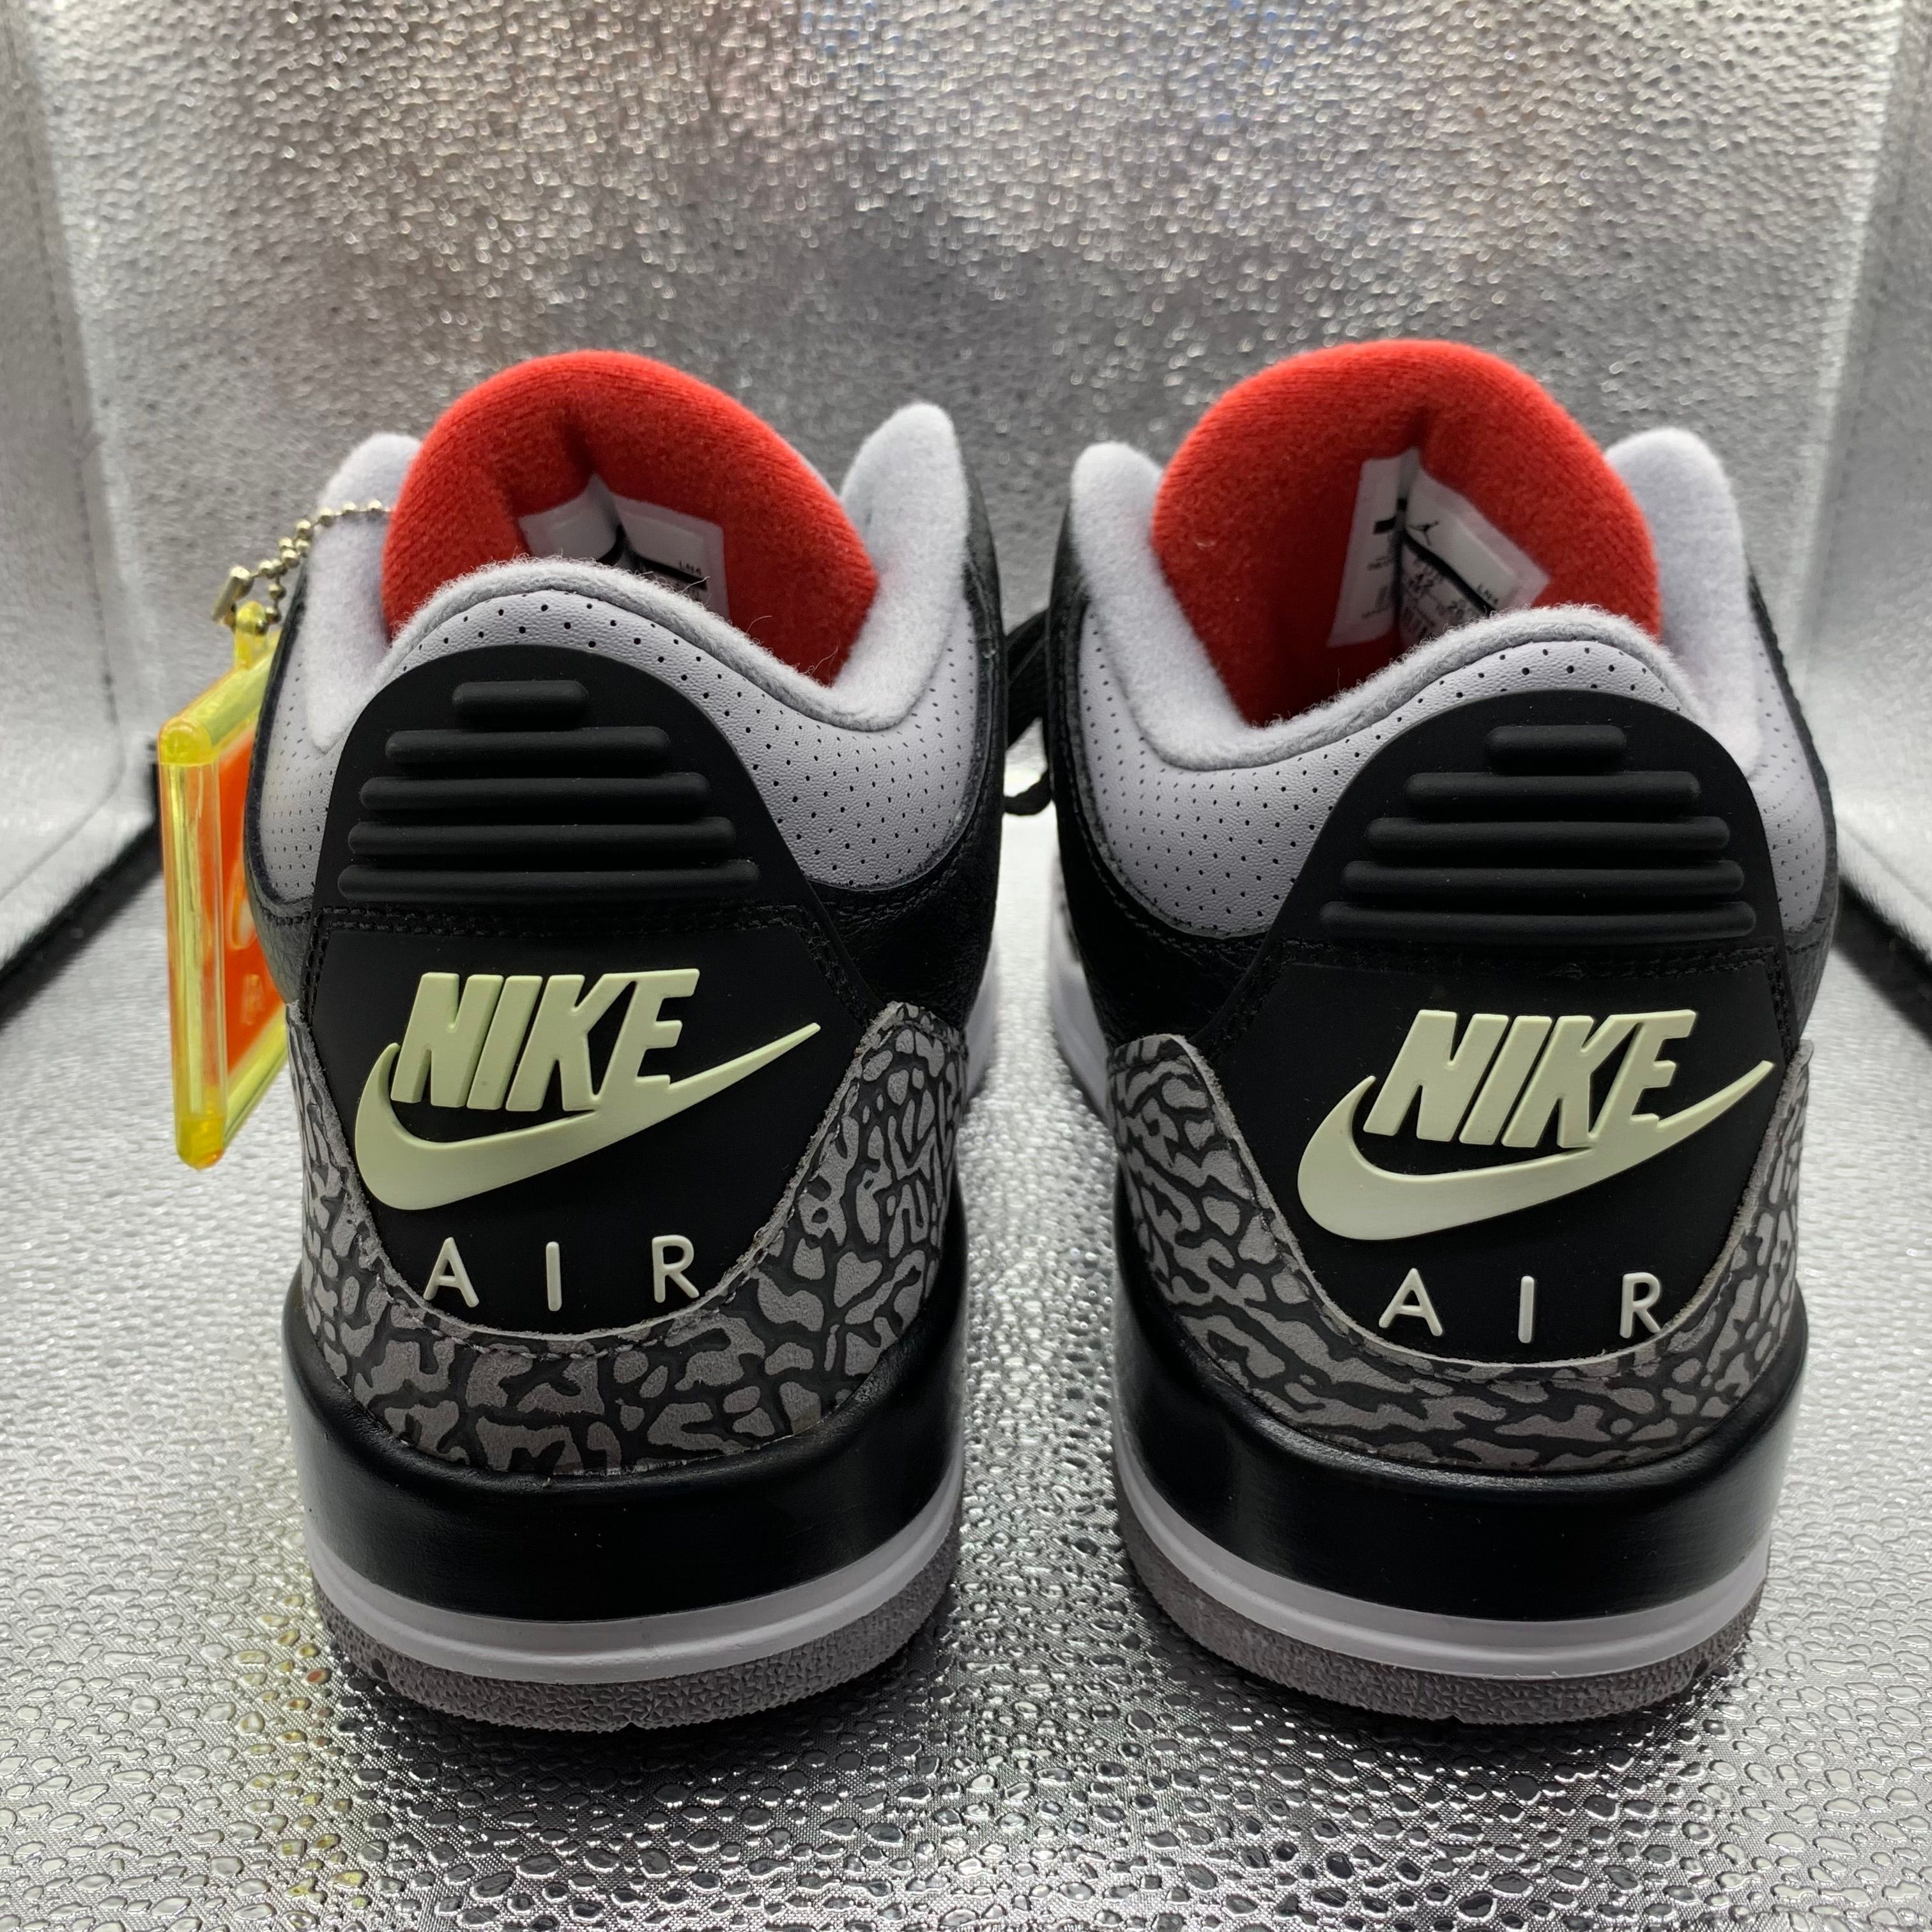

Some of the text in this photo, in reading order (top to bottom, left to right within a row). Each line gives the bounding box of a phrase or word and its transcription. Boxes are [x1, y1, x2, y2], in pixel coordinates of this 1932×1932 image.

[390, 968, 700, 1112] NIKE
[1363, 1009, 1697, 1149] NIKE
[423, 1234, 700, 1312] AIR
[1378, 1268, 1662, 1344] AIR
